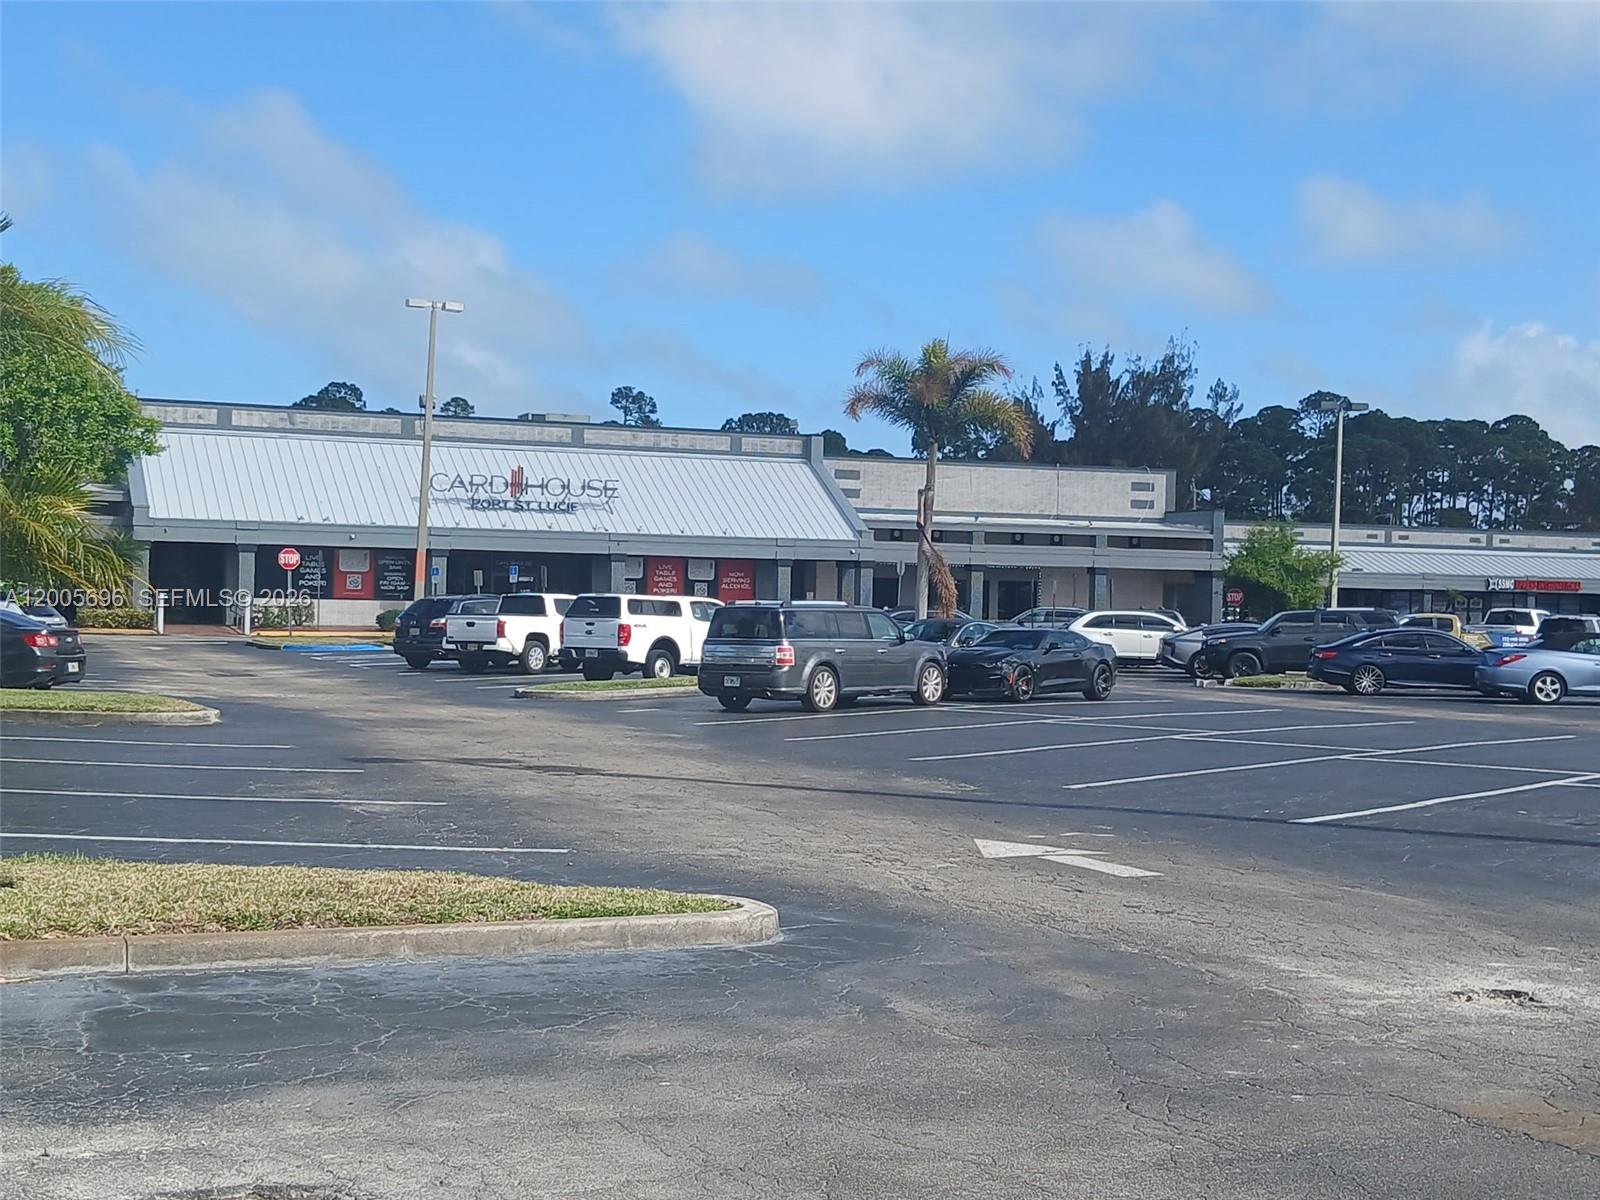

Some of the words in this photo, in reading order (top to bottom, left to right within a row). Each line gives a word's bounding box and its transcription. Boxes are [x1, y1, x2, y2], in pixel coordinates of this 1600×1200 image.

[429, 473, 508, 495] CARD
[525, 476, 620, 498] HOUSE
[471, 498, 511, 510] PORT
[538, 500, 579, 512] LUCIE
[279, 553, 300, 564] STOP
[1226, 592, 1243, 601] STOP
